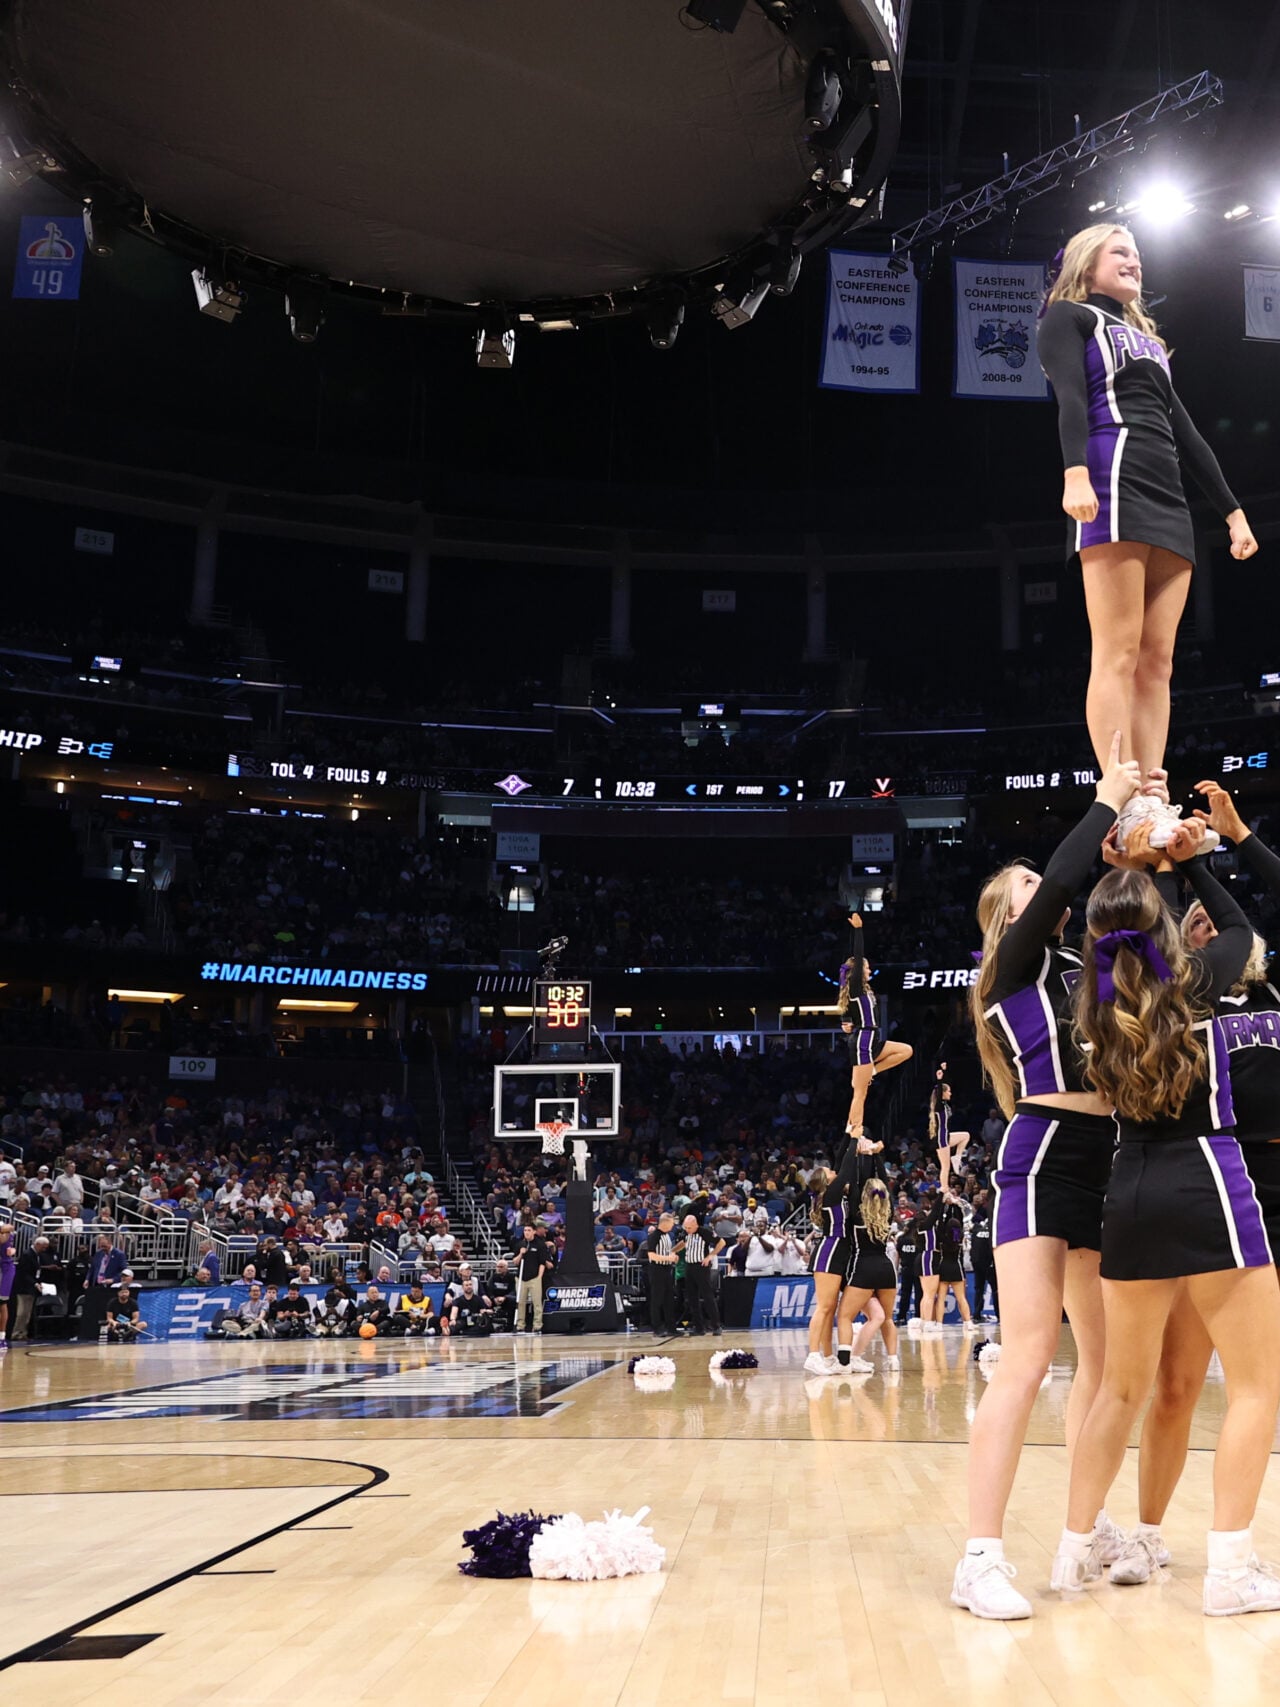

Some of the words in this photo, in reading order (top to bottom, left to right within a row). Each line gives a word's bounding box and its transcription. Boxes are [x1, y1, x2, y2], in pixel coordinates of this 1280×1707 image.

[848, 268, 899, 279] EASTERN
[32, 270, 63, 295] 49
[836, 280, 911, 293] CONFERENCE
[976, 276, 1025, 287] EASTERN
[840, 294, 905, 306] CHAMPIONS
[964, 288, 1038, 300] CONFERENCE
[968, 302, 1033, 314] CHAMPIONS
[1263, 296, 1273, 313] 6
[850, 364, 889, 375] 1994-95
[981, 372, 1022, 383] 2008-09
[82, 534, 105, 546] 215
[375, 574, 396, 585] 216
[270, 762, 296, 779] TOL
[303, 765, 314, 779] 4
[327, 767, 370, 784] FOULS
[376, 770, 388, 786] 4
[1005, 773, 1046, 790] FOULS
[1050, 772, 1061, 787] 2
[1073, 770, 1097, 785] TOL
[562, 778, 575, 796] 7
[615, 781, 656, 798] 10:32
[705, 783, 724, 796] 1ST
[736, 785, 764, 796] PERIOD
[828, 780, 846, 798] 17
[201, 962, 428, 991] #MARCHMADNESS
[929, 968, 981, 989] FIRS
[547, 986, 584, 1001] 10:32
[547, 1001, 580, 1027] 30
[179, 1060, 206, 1073] 109
[901, 1244, 916, 1253] 403
[556, 1288, 589, 1299] MARCH
[560, 1298, 603, 1308] MADNESS
